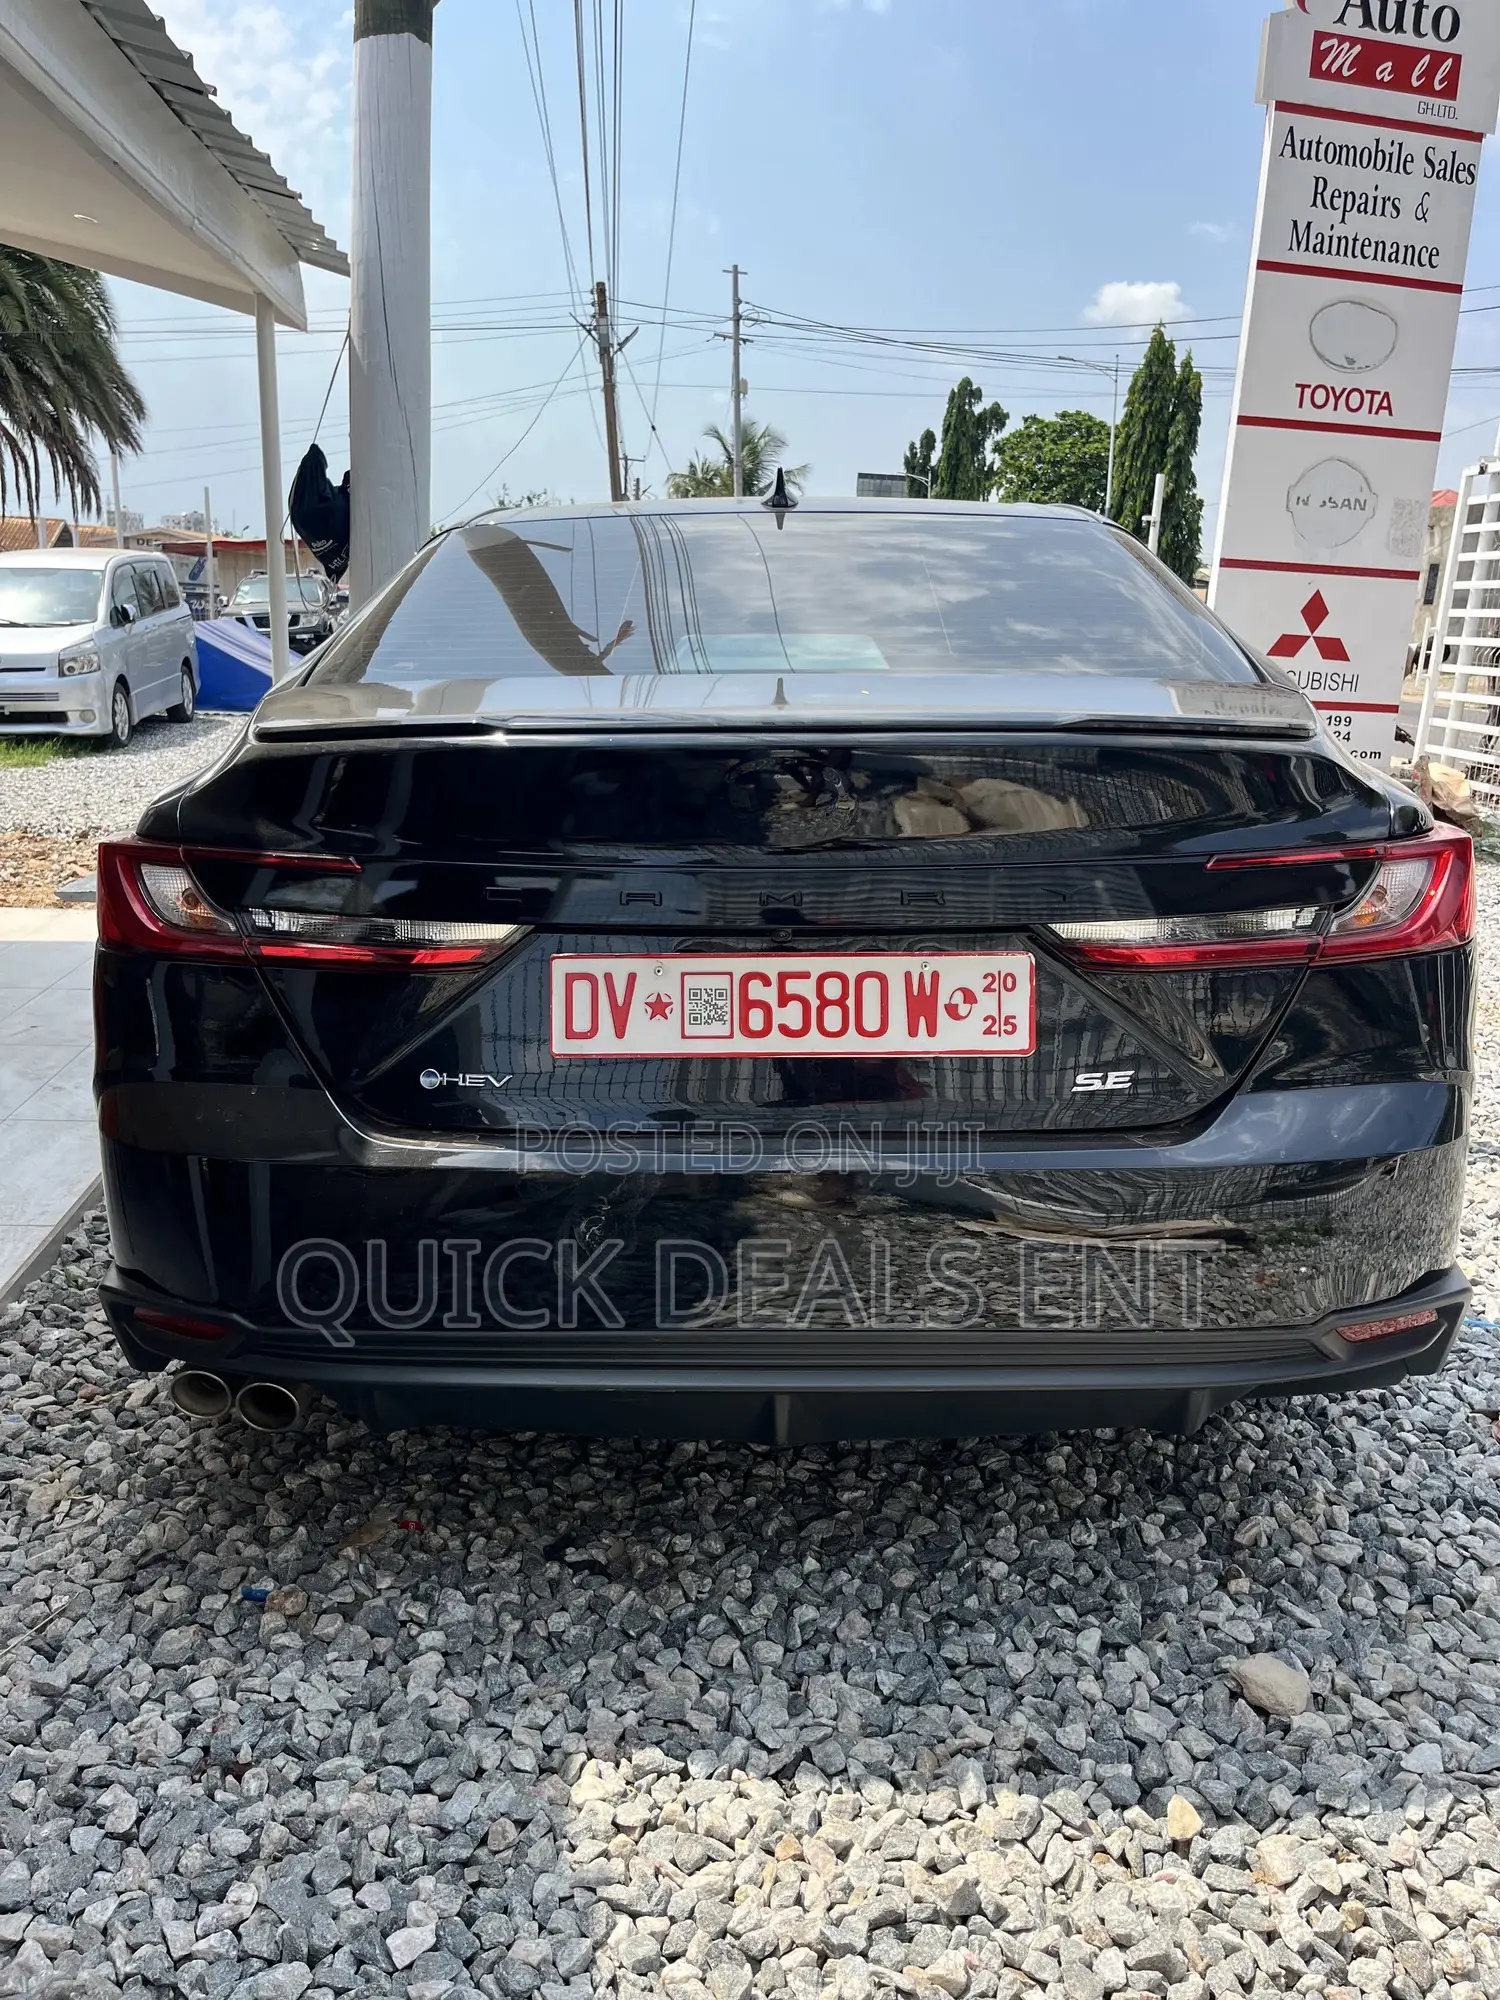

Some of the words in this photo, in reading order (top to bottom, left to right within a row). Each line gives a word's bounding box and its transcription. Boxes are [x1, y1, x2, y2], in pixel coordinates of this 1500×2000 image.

[1332, 0, 1461, 43] Auto
[1320, 37, 1453, 91] Mall
[1417, 100, 1458, 120] GH.LTD.
[1278, 126, 1415, 176] Automobile
[1423, 146, 1477, 185] Sales
[1310, 175, 1401, 225] Repairs
[1414, 191, 1431, 223] &
[1287, 219, 1440, 269] Maintenance
[1295, 383, 1394, 416] TOYOTA
[1326, 715, 1352, 727] 199
[564, 971, 637, 1040] DV
[738, 970, 889, 1040] 6580
[905, 969, 940, 1039] W
[1070, 1070, 1136, 1092] SE
